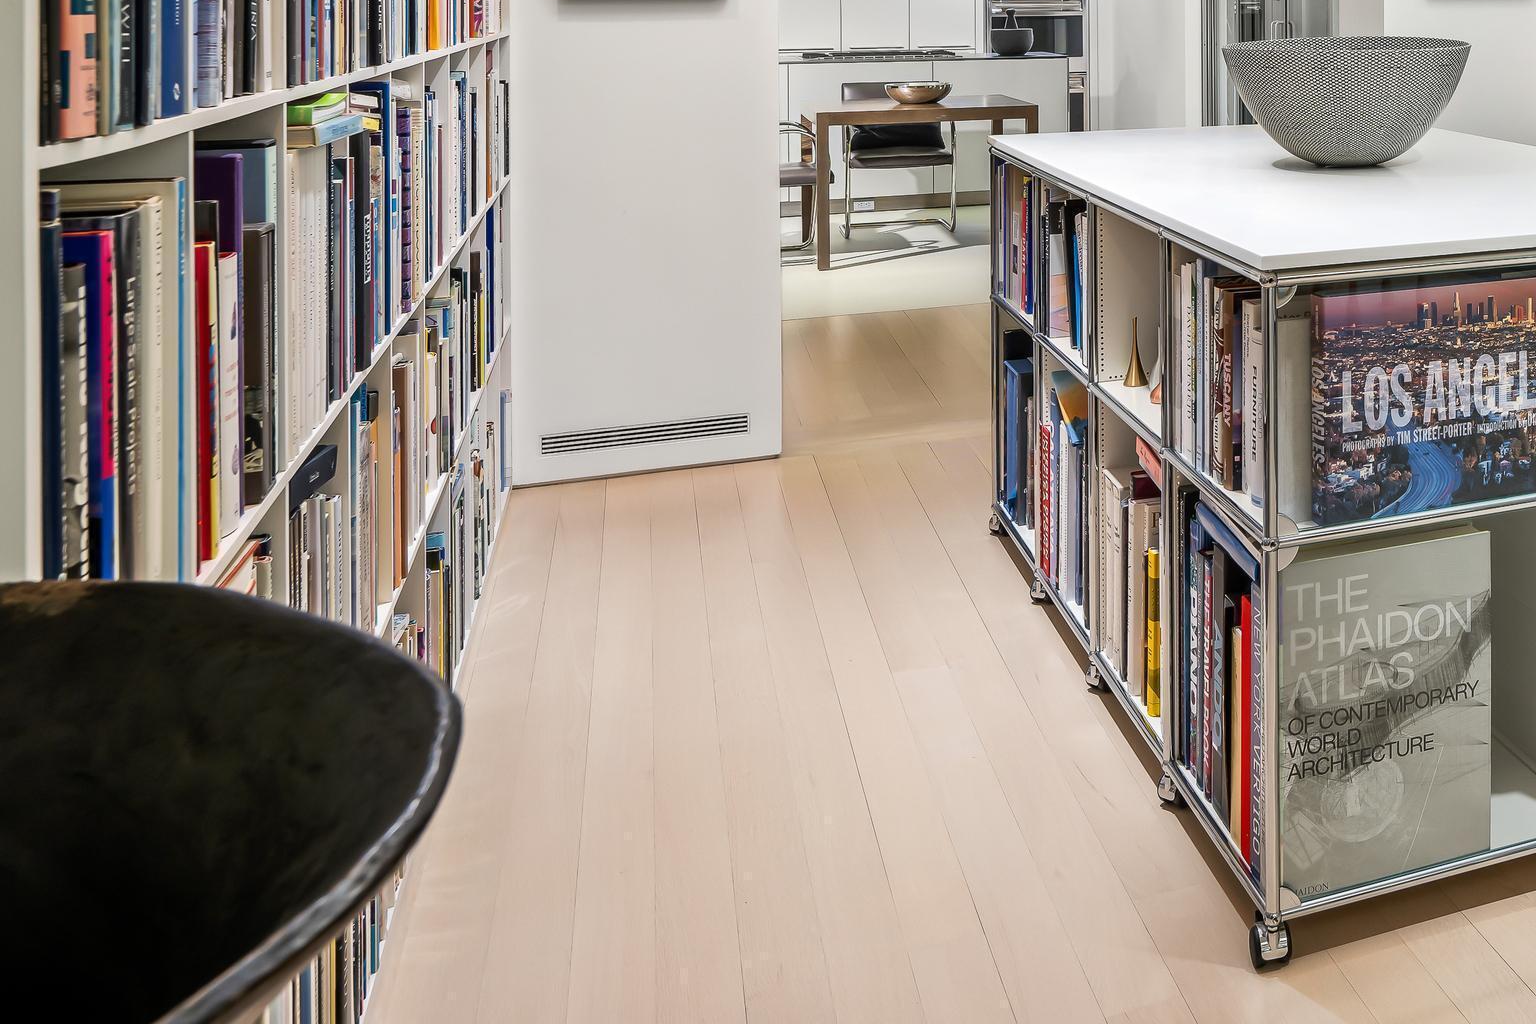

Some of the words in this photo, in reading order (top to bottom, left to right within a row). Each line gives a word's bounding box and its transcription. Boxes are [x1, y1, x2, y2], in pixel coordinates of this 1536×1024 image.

[1223, 354, 1231, 428] TUSCANY
[1250, 365, 1258, 462] FURNITURE
[1342, 364, 1413, 434] LOS
[125, 406, 136, 496] Projects
[1342, 434, 1385, 452] PHOTOGRAPHS
[1387, 436, 1394, 446] BY
[1396, 431, 1411, 445] TIM
[1413, 422, 1472, 442] STREET-PORTER
[1286, 574, 1368, 621] THE
[1252, 606, 1261, 658] NEW
[1290, 597, 1472, 667] PHAIDON
[1213, 619, 1222, 751] ANDO
[1252, 671, 1261, 737] YORK
[1287, 652, 1415, 712] ATLAS
[1288, 717, 1315, 736] OF
[1319, 680, 1479, 730] CONTEMPORARY
[1287, 734, 1435, 782] ARCHITECTURE
[1288, 728, 1361, 758] WORLD
[1251, 746, 1261, 855] VERTIGO
[1296, 881, 1329, 896] AIDON
